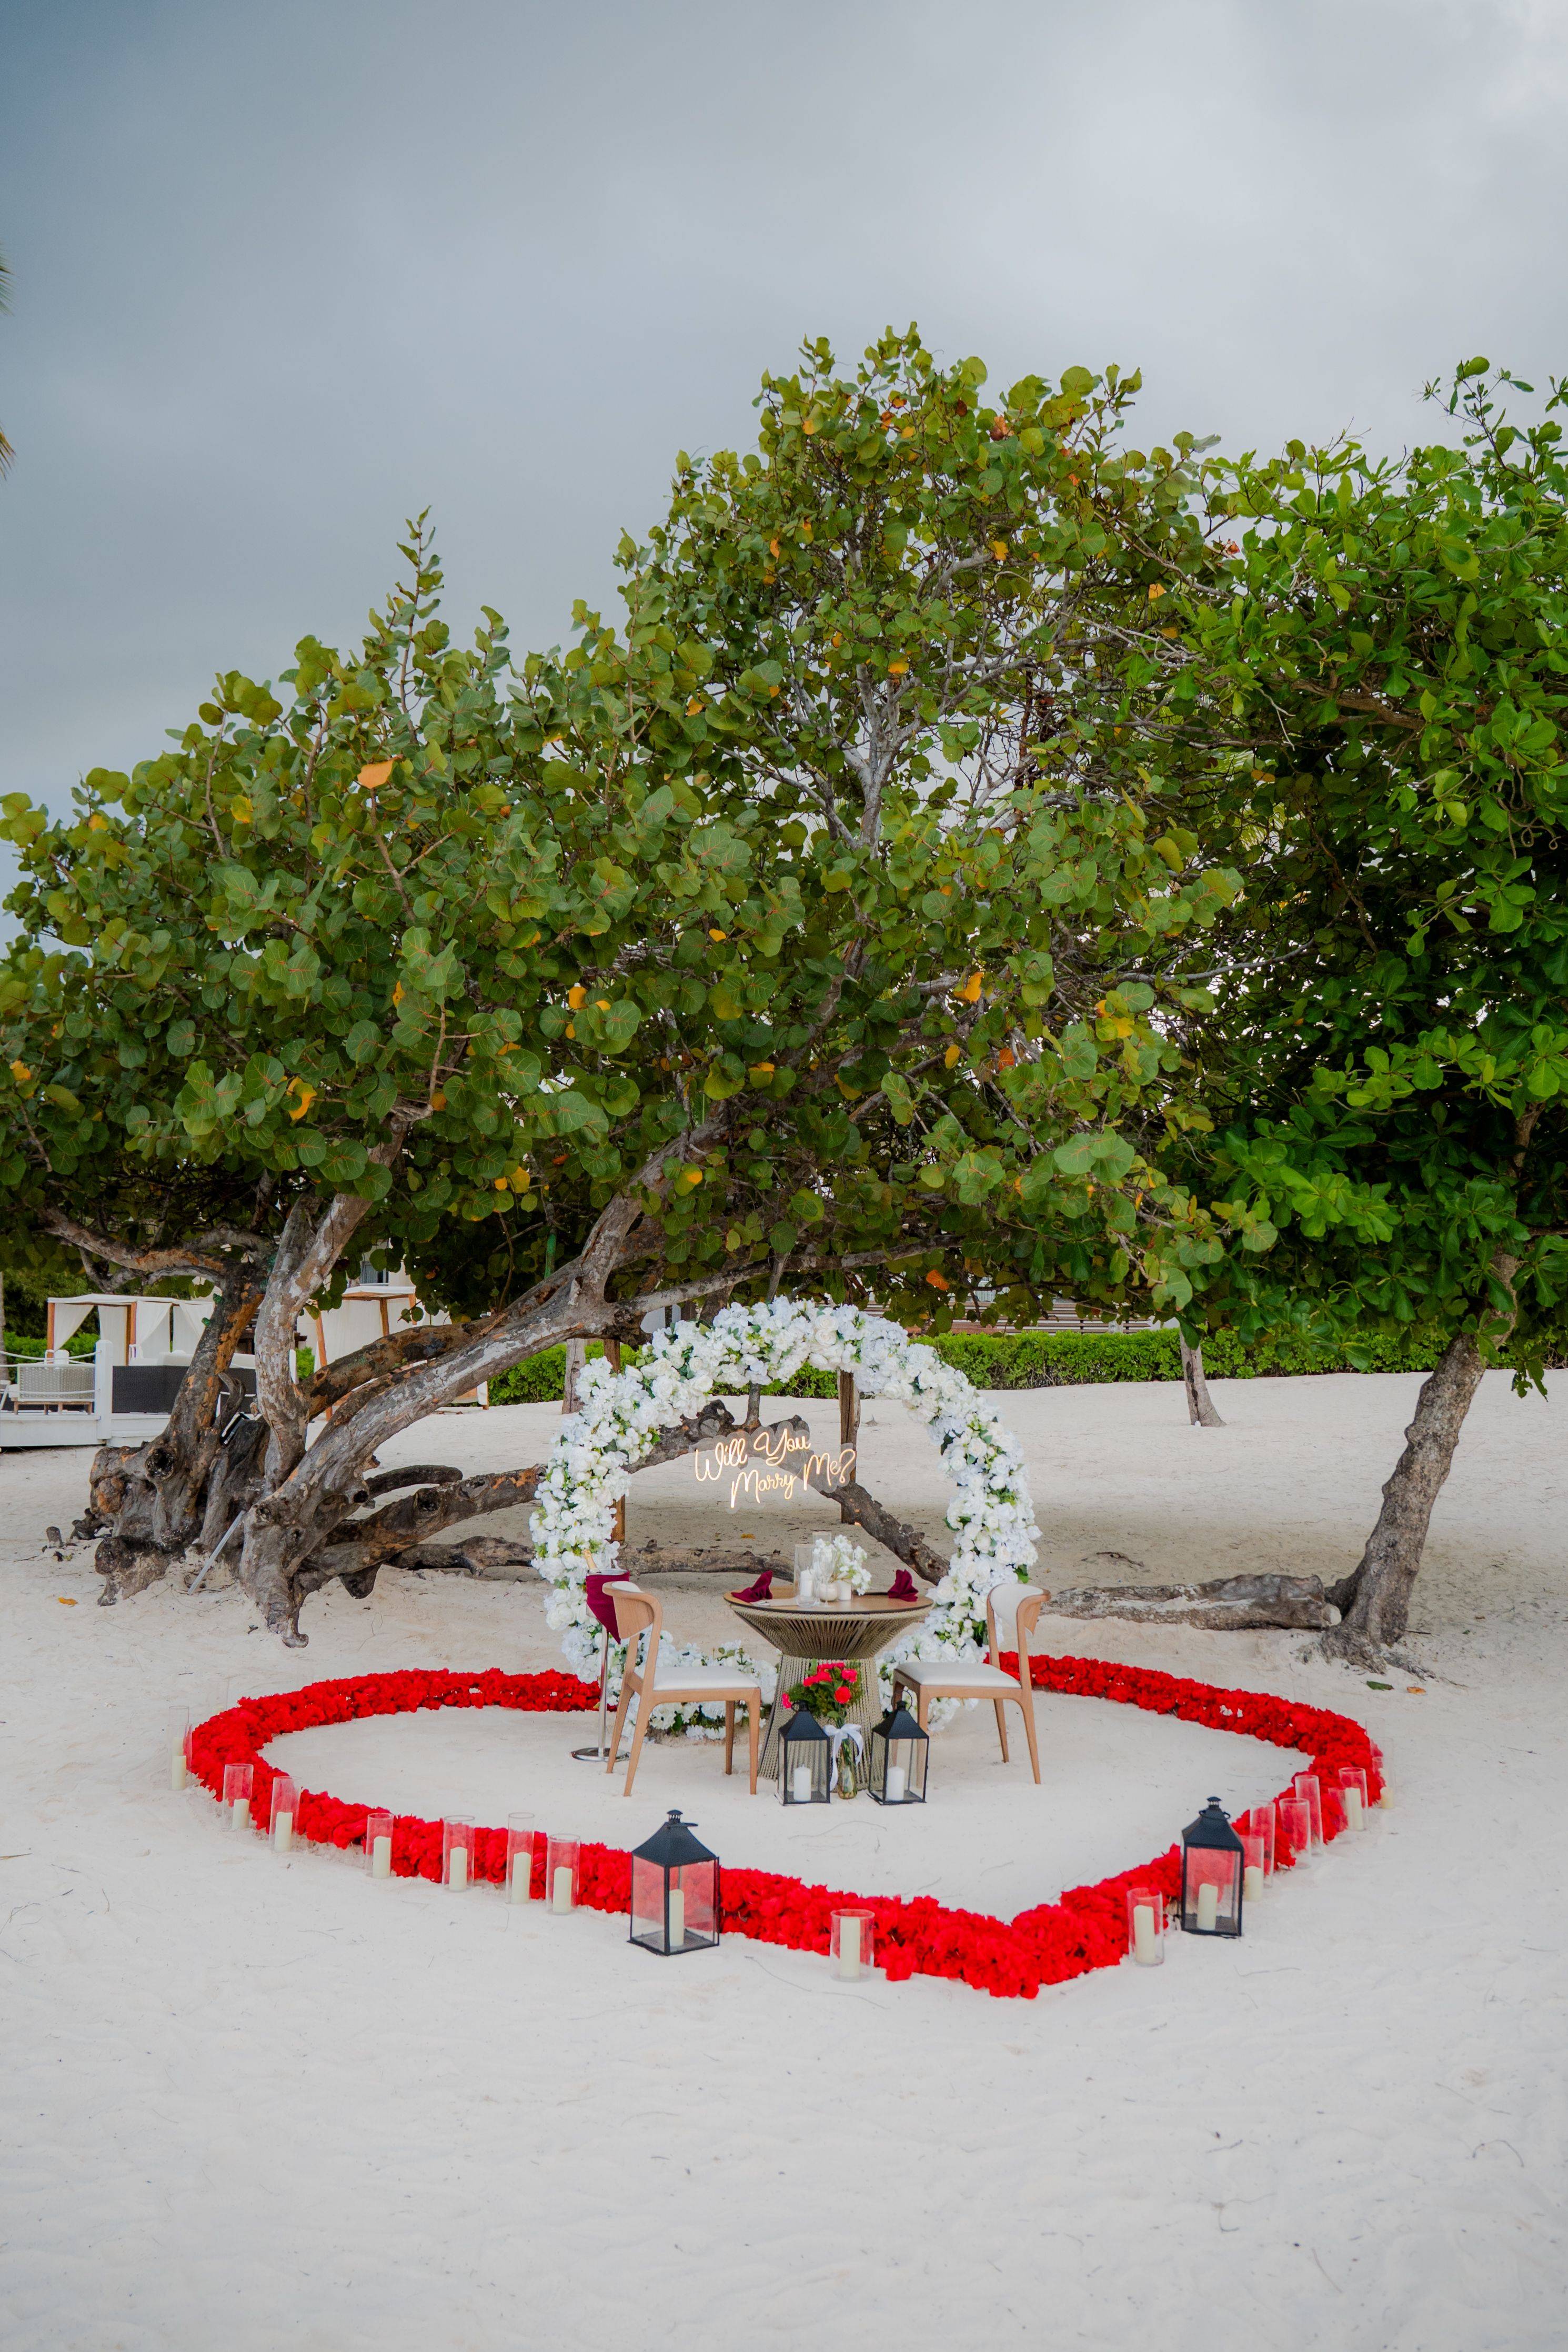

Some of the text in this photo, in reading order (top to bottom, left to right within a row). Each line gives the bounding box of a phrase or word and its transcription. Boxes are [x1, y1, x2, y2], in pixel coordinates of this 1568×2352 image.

[695, 1428, 811, 1481] Will You
[730, 1448, 856, 1508] Marry Me?
